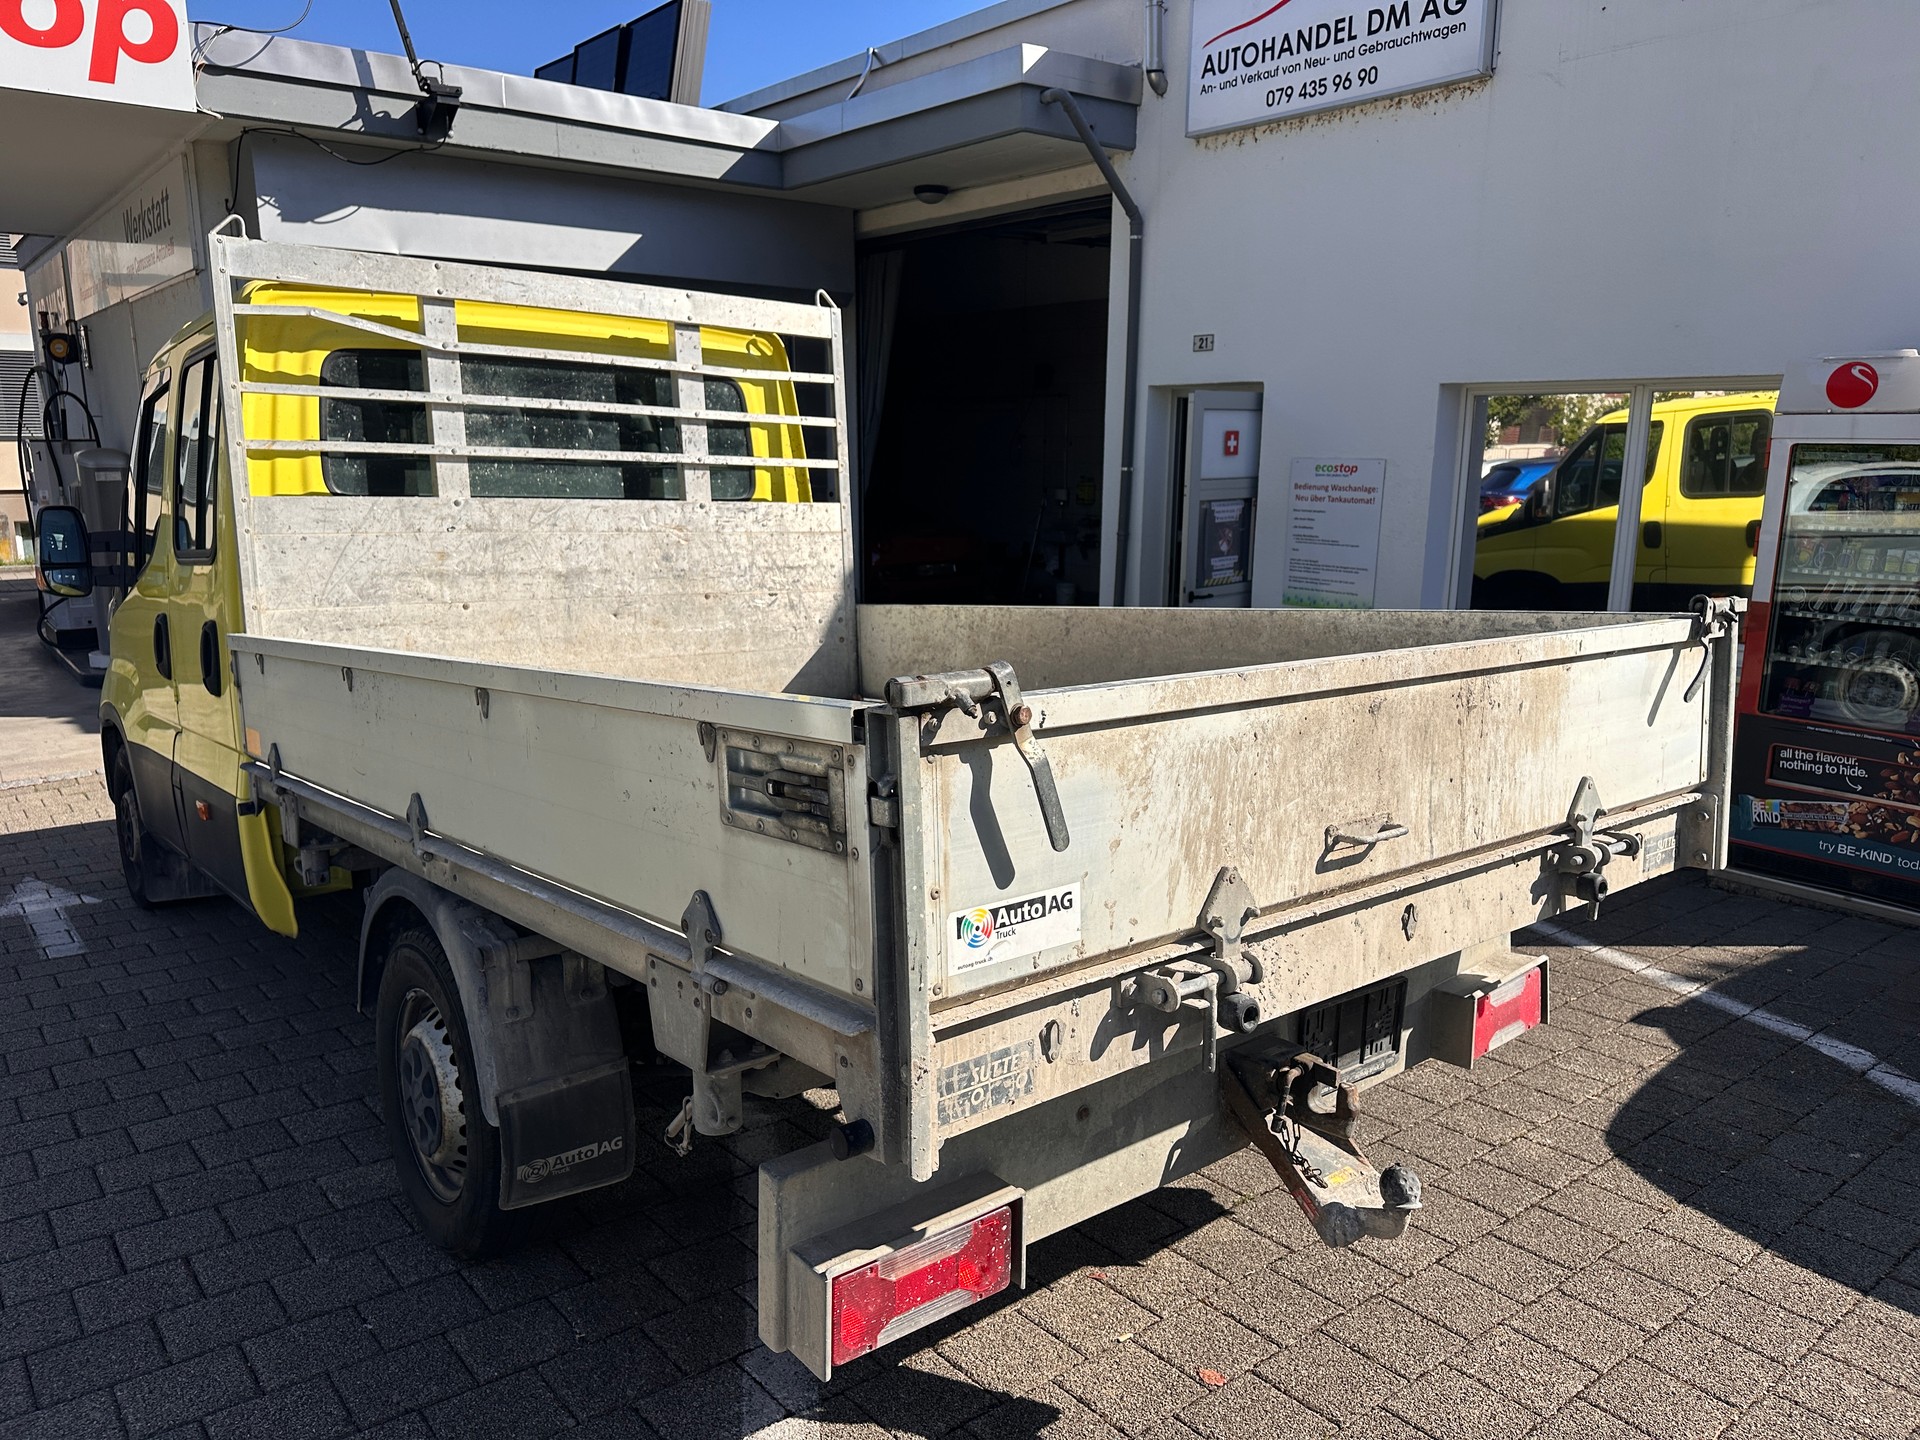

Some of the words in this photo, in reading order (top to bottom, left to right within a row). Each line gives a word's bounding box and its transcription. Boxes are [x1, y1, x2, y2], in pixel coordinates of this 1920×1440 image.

[1200, 15, 1358, 79] AUTOHANDEL
[1367, 1, 1410, 36] DM
[1420, 0, 1467, 23] AG
[1200, 84, 1217, 95] An-
[1219, 76, 1238, 90] und
[1240, 66, 1279, 85] Verkauf
[1282, 63, 1301, 75] von
[1304, 57, 1330, 70] Neu-
[1334, 47, 1355, 62] und
[1358, 22, 1467, 56] Gebrauchtwagen
[1266, 85, 1294, 107] 079
[1298, 77, 1328, 100] 435
[1332, 72, 1353, 93] 96
[1357, 65, 1379, 88] 90
[122, 186, 172, 244] Werkstatt
[1198, 338, 1208, 349] 21
[1315, 463, 1358, 475] ecostop
[1294, 482, 1330, 493] Bedienung
[1331, 484, 1379, 495] Waschanlage:
[1295, 494, 1309, 502] Neu
[1310, 494, 1326, 503] über
[1327, 495, 1376, 505] Tankautomat!
[1780, 748, 1793, 758] all
[1795, 749, 1814, 761] the
[1816, 751, 1859, 766] flavour.
[1779, 760, 1823, 775] nothing
[1825, 763, 1837, 774] to
[1839, 764, 1868, 778] hide.
[1752, 811, 1780, 824] KIND
[1819, 840, 1835, 854] try
[1897, 856, 1920, 870] tod
[995, 901, 1043, 928] Auto
[1047, 891, 1073, 914] AG
[996, 927, 1017, 940] Truck
[552, 1147, 595, 1169] Auto
[599, 1136, 623, 1155] AG
[552, 1166, 570, 1176] Truck
